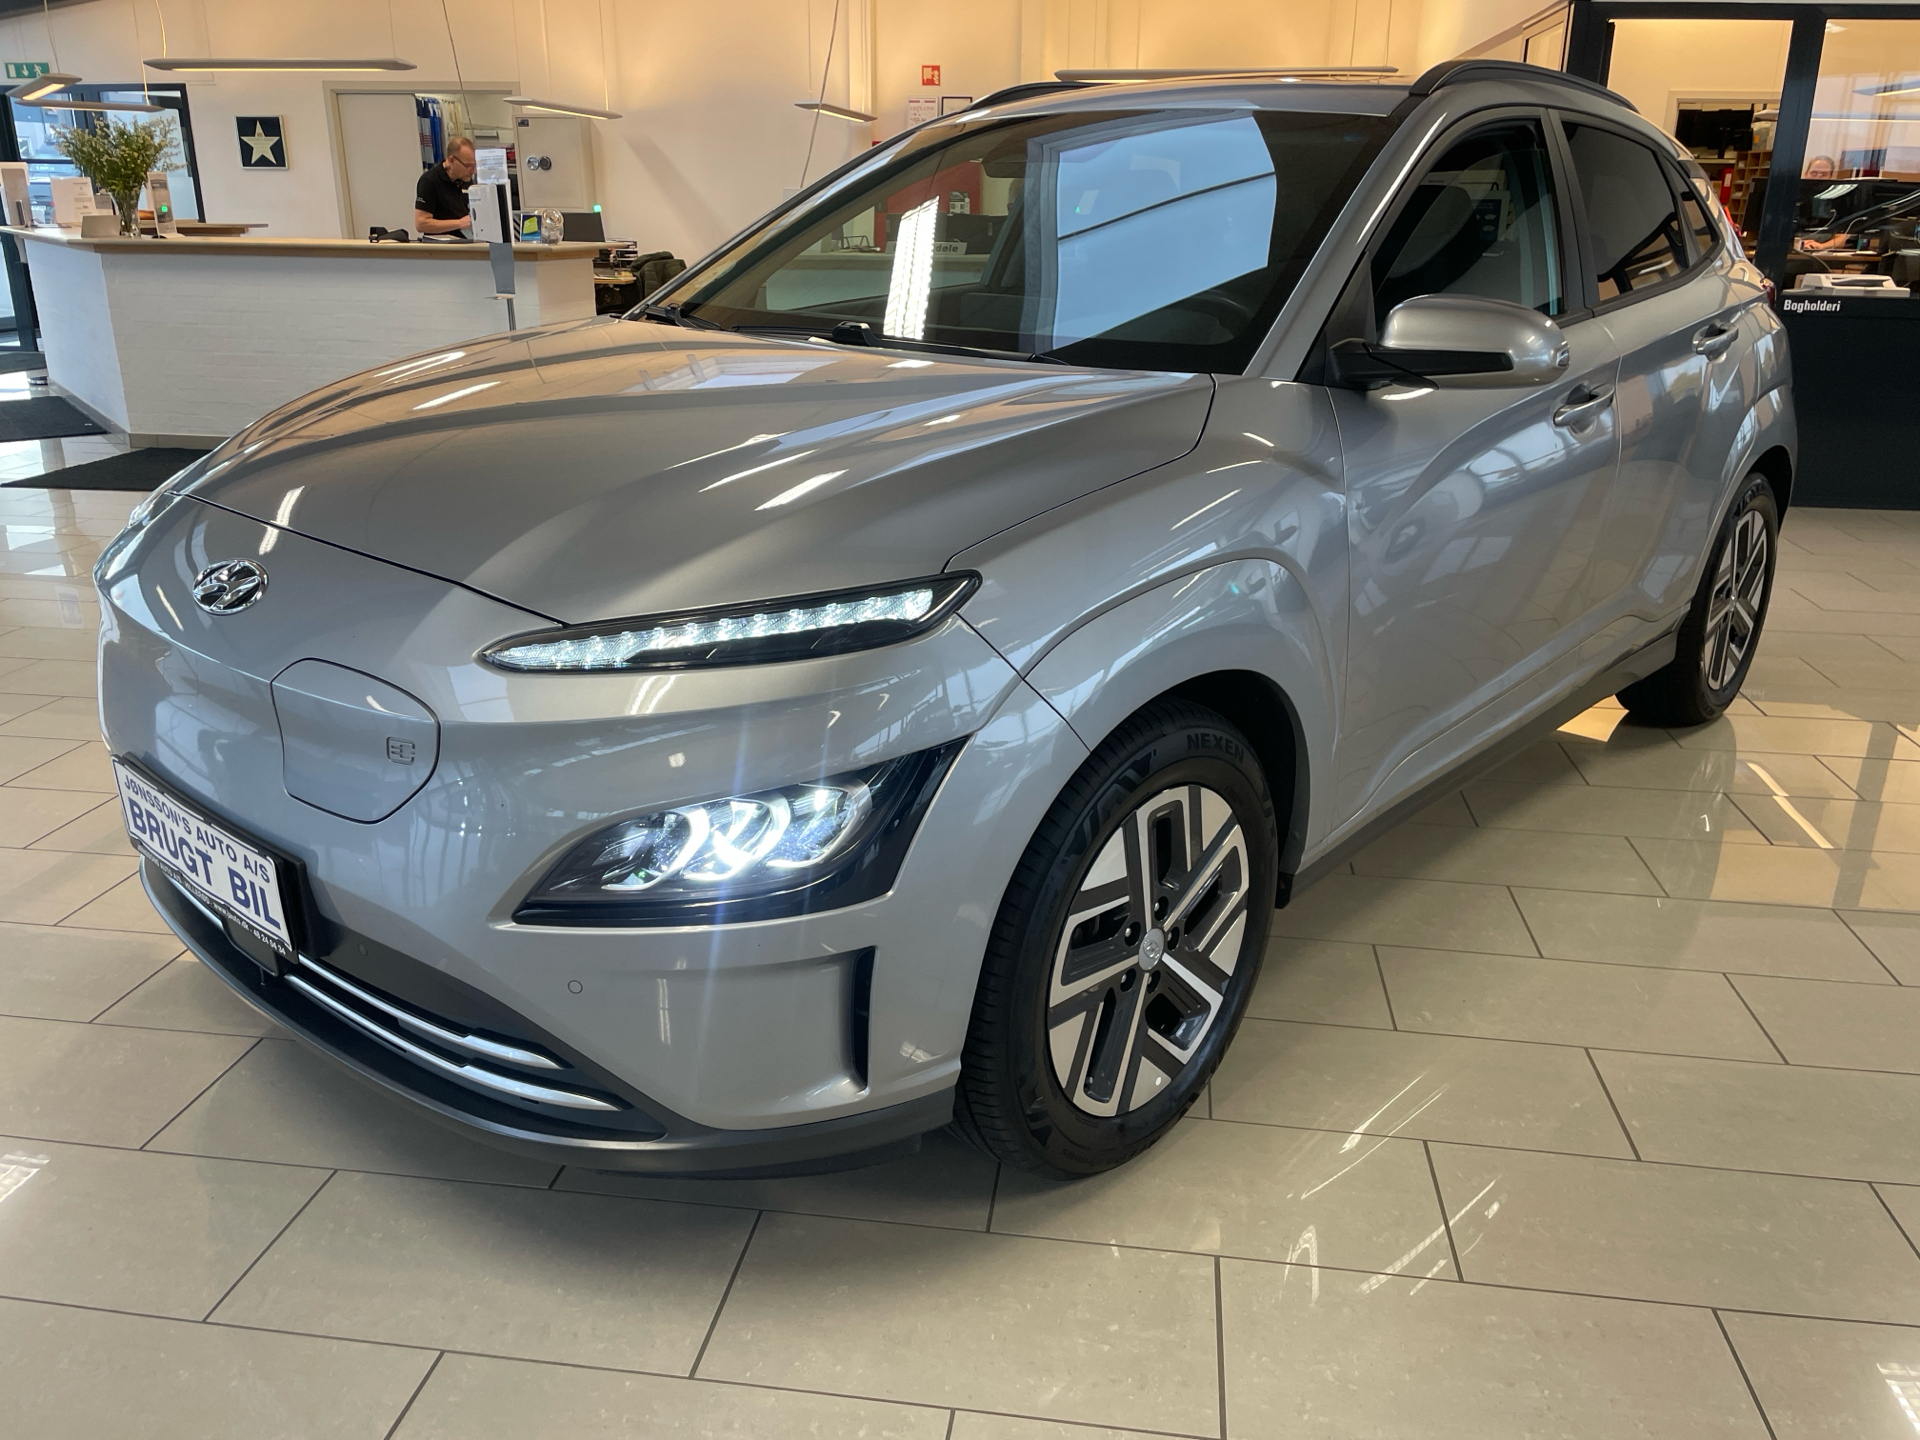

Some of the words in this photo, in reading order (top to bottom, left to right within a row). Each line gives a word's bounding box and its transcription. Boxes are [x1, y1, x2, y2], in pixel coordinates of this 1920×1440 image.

[1783, 299, 1841, 313] Bogholderi
[1186, 732, 1245, 764] NEXEN
[124, 774, 192, 835] JØNSSON'S
[196, 825, 238, 862] AUTO
[243, 853, 271, 884] A/S
[127, 796, 214, 886] BRUGT
[228, 866, 281, 930] BIL
